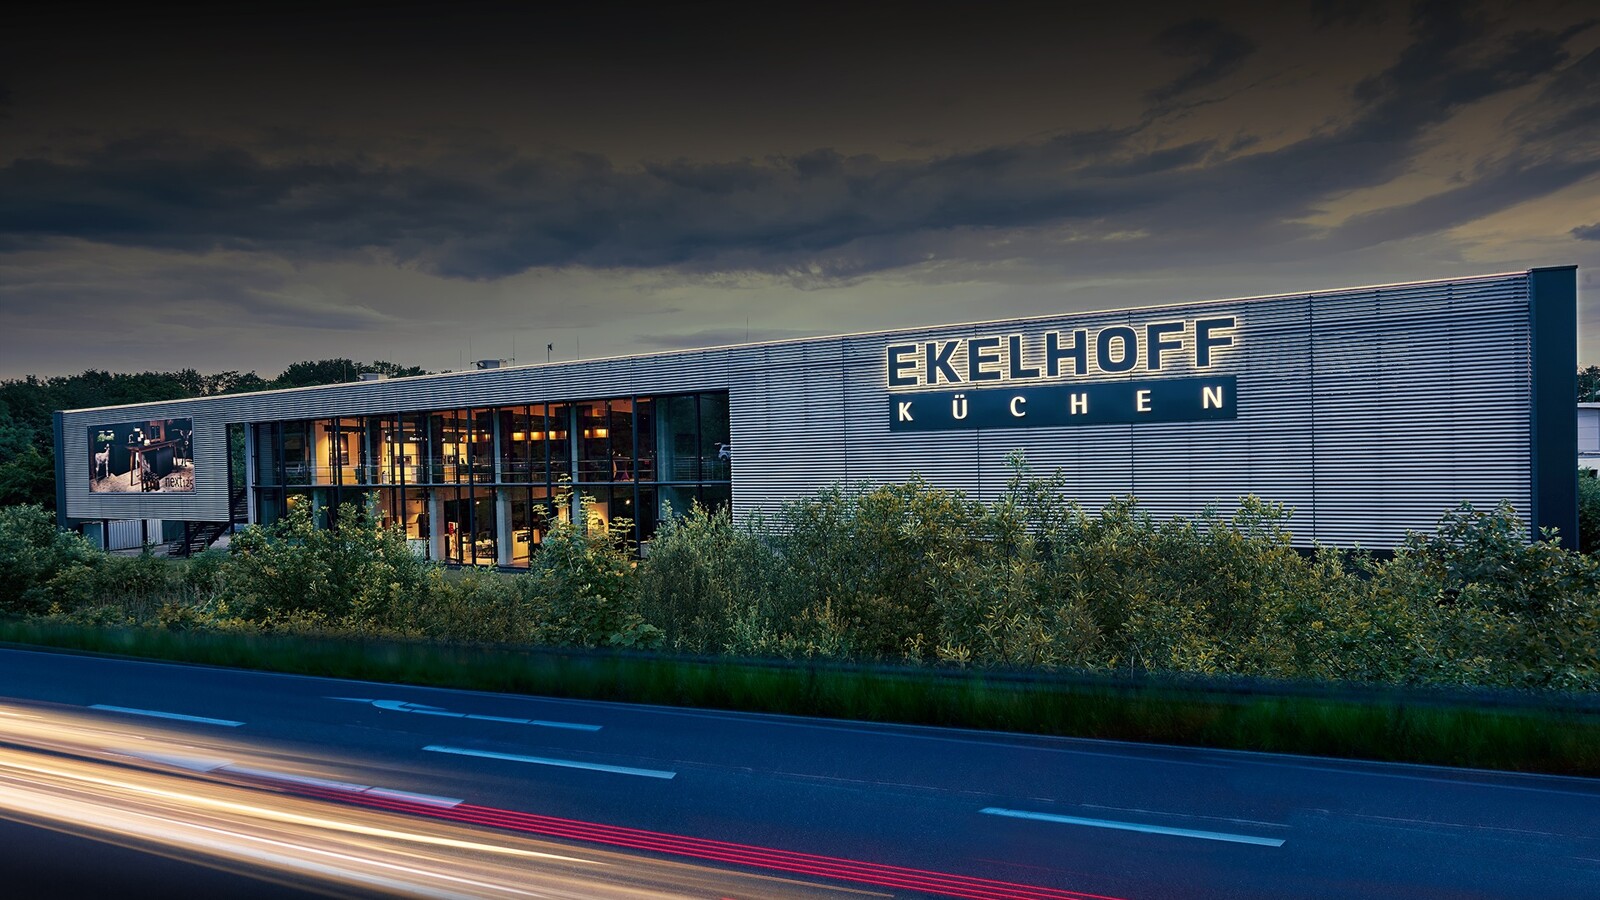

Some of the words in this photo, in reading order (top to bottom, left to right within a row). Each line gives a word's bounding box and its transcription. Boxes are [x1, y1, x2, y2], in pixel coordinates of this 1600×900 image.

[887, 316, 1237, 388] EKELHOFF
[898, 386, 1223, 421] KÜCHEN
[165, 475, 193, 490] next125
